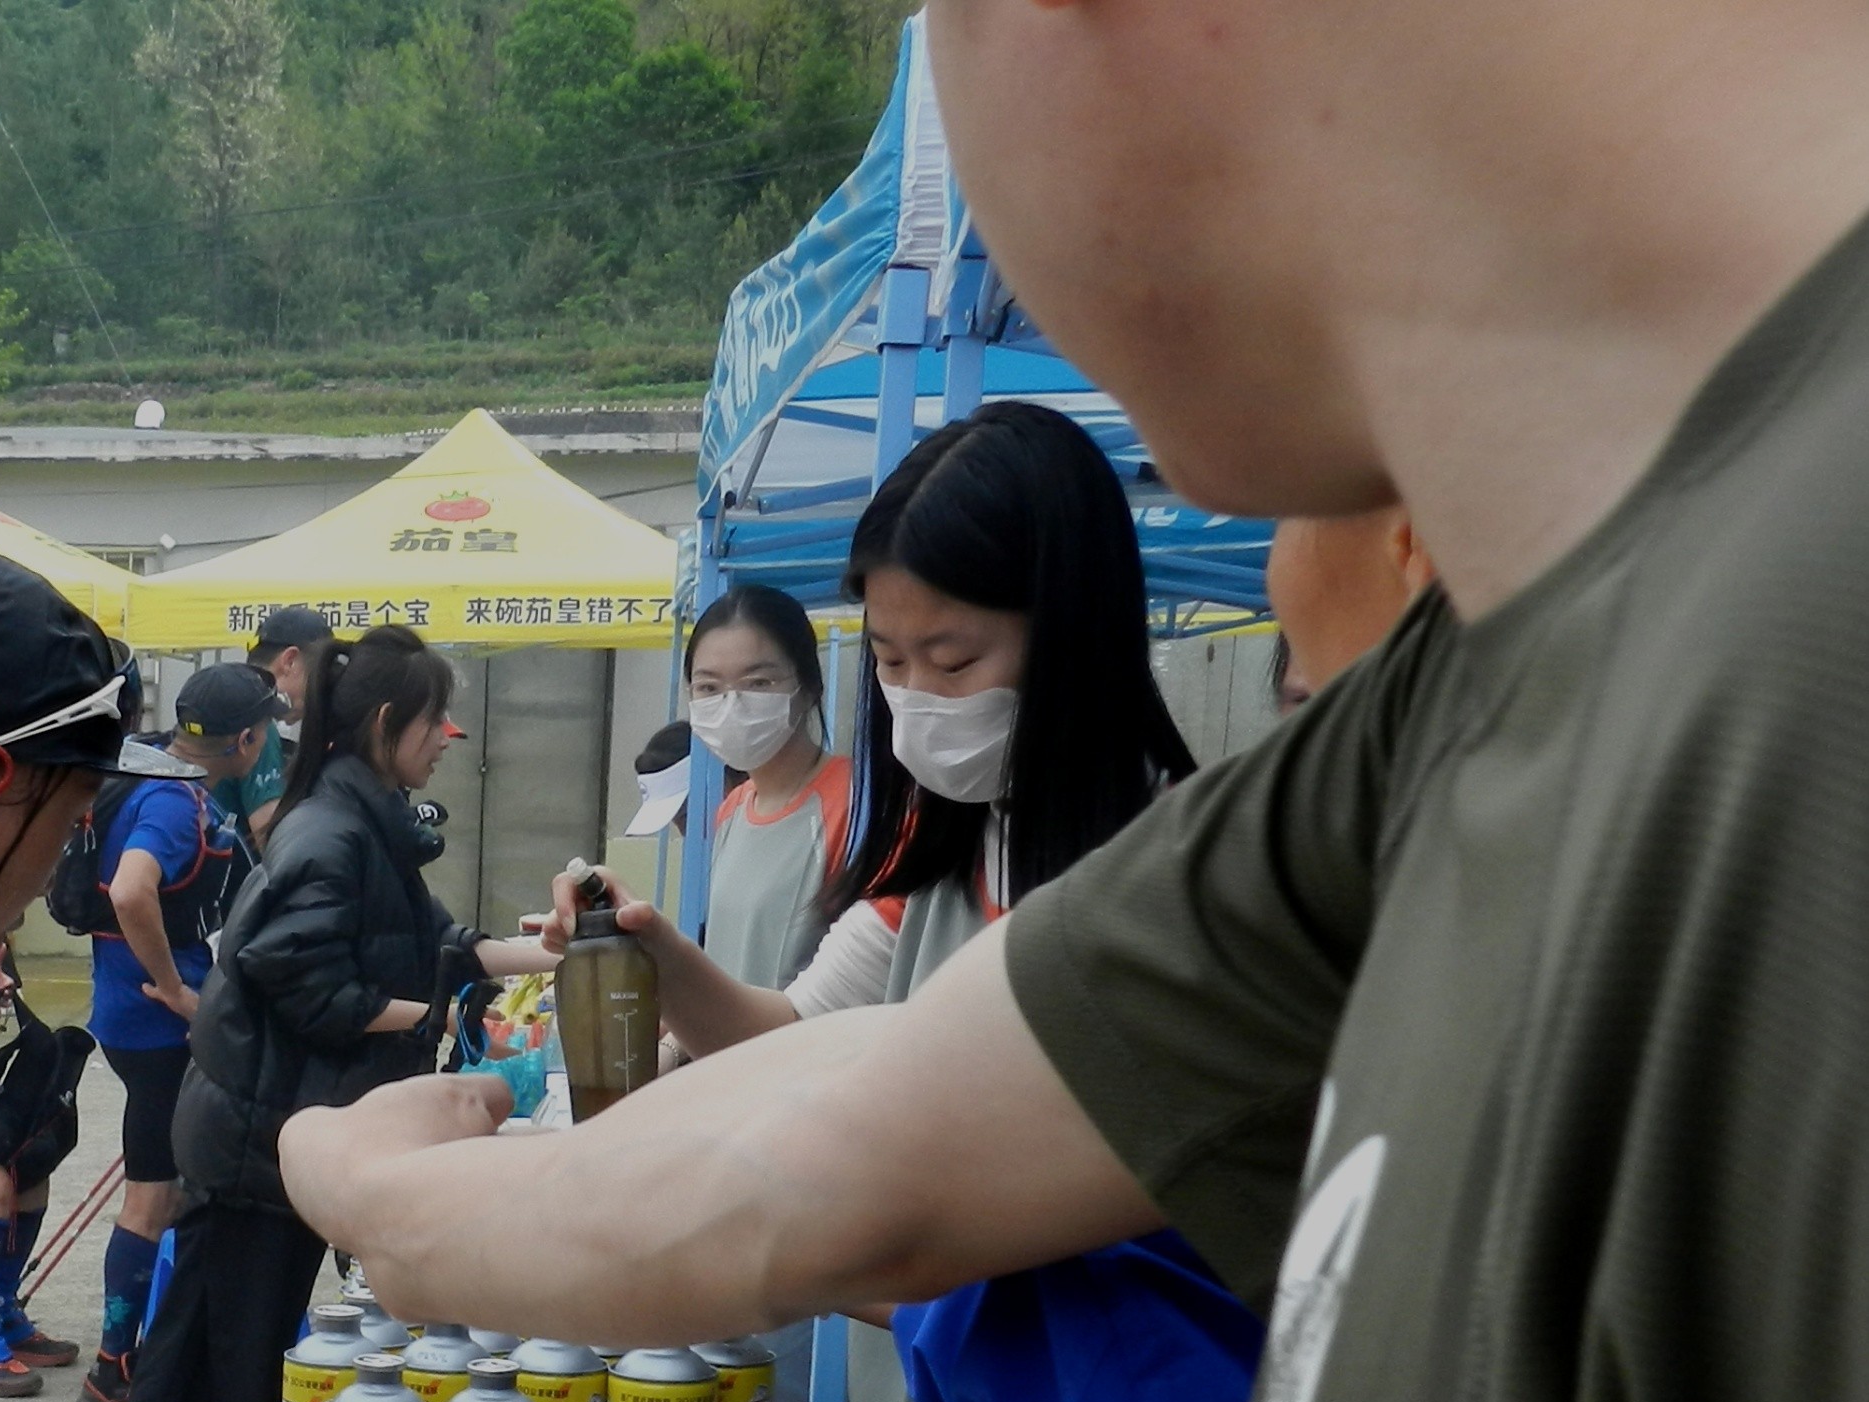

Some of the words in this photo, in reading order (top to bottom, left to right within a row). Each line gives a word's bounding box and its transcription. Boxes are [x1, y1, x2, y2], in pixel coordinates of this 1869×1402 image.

[389, 528, 518, 553] 茄皇
[228, 599, 430, 633] 新茄是个宝
[466, 596, 672, 626] 来碗茄皇错不了
